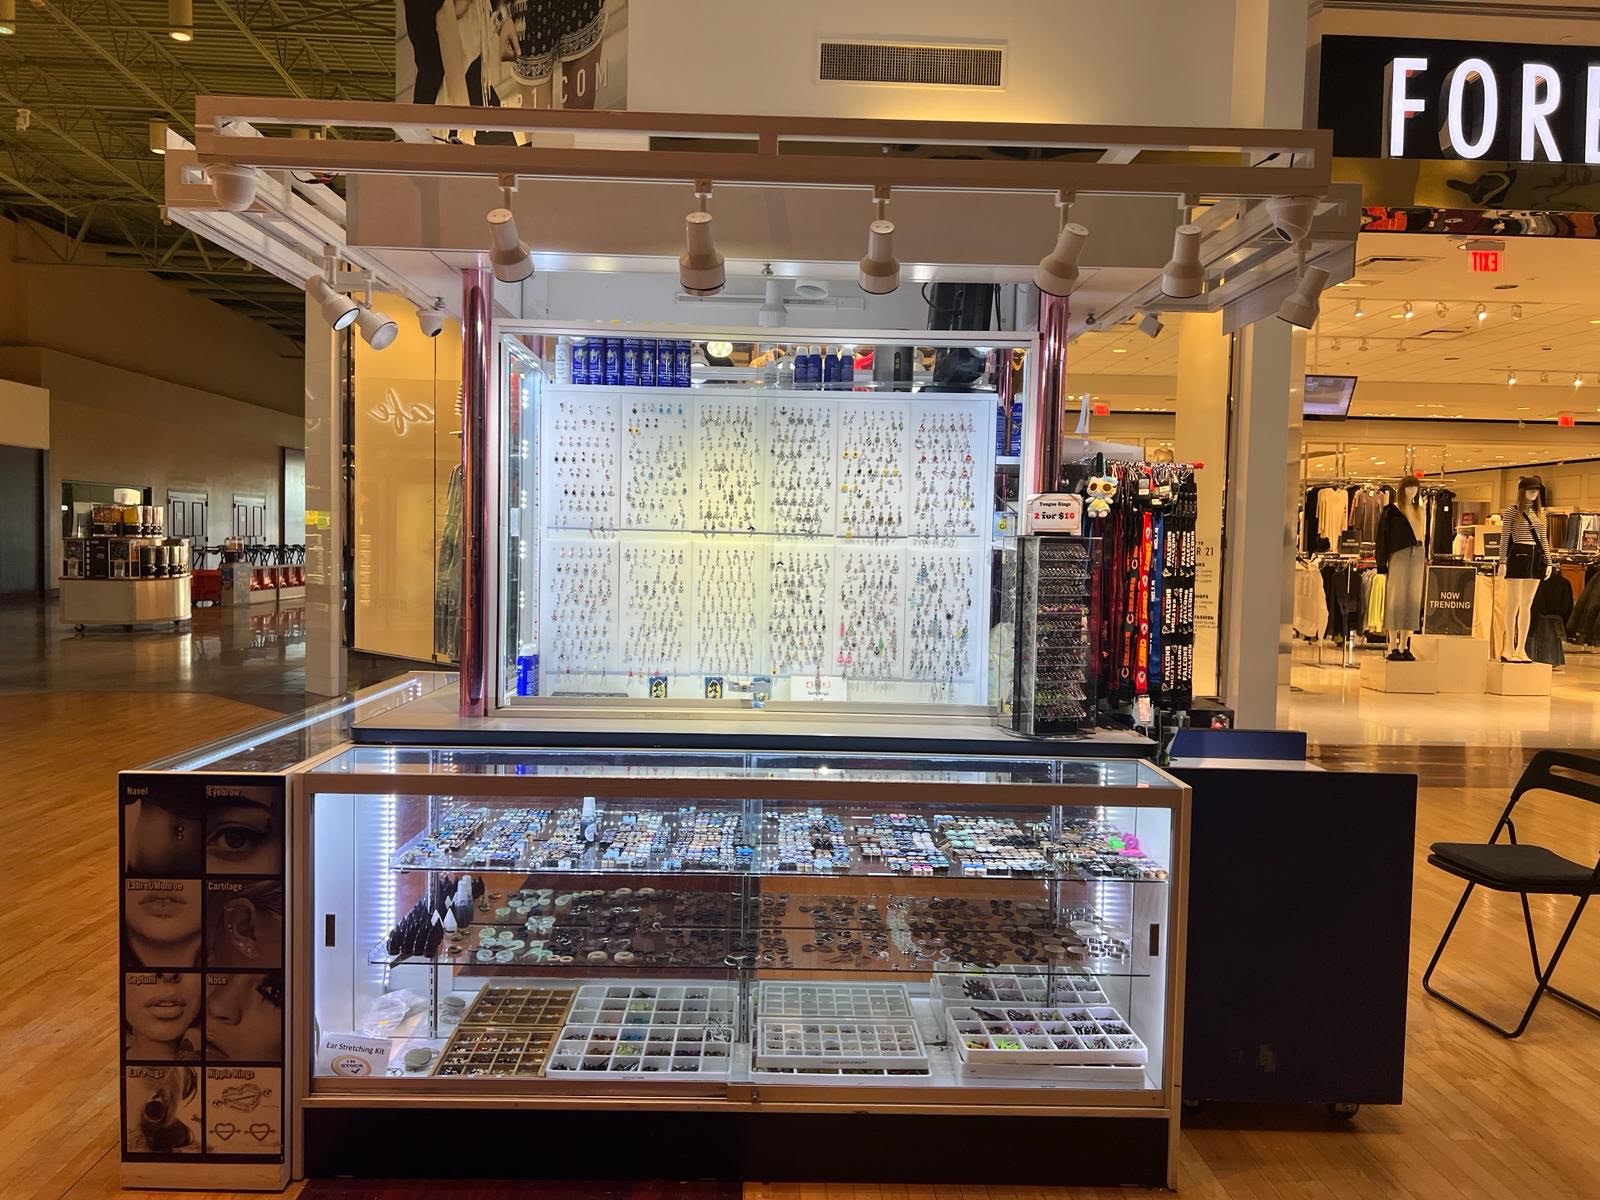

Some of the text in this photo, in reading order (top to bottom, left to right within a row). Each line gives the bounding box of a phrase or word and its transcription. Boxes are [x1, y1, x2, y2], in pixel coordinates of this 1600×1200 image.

[1042, 511, 1057, 519] for
[1058, 511, 1075, 520] $10
[1205, 547, 1214, 556] 21
[1440, 592, 1460, 600] NOW
[1429, 600, 1471, 609] TRENDING
[127, 786, 149, 796] Navel
[208, 787, 240, 797] Eyebrow
[127, 881, 183, 891] Labret/Monroe
[208, 881, 243, 892] Cartilage
[127, 974, 156, 986] Septum
[208, 975, 227, 985] Nose
[339, 1043, 374, 1055] Stretching
[128, 1068, 164, 1079] Ear Plugs
[207, 1069, 255, 1079] Nipple Rings
